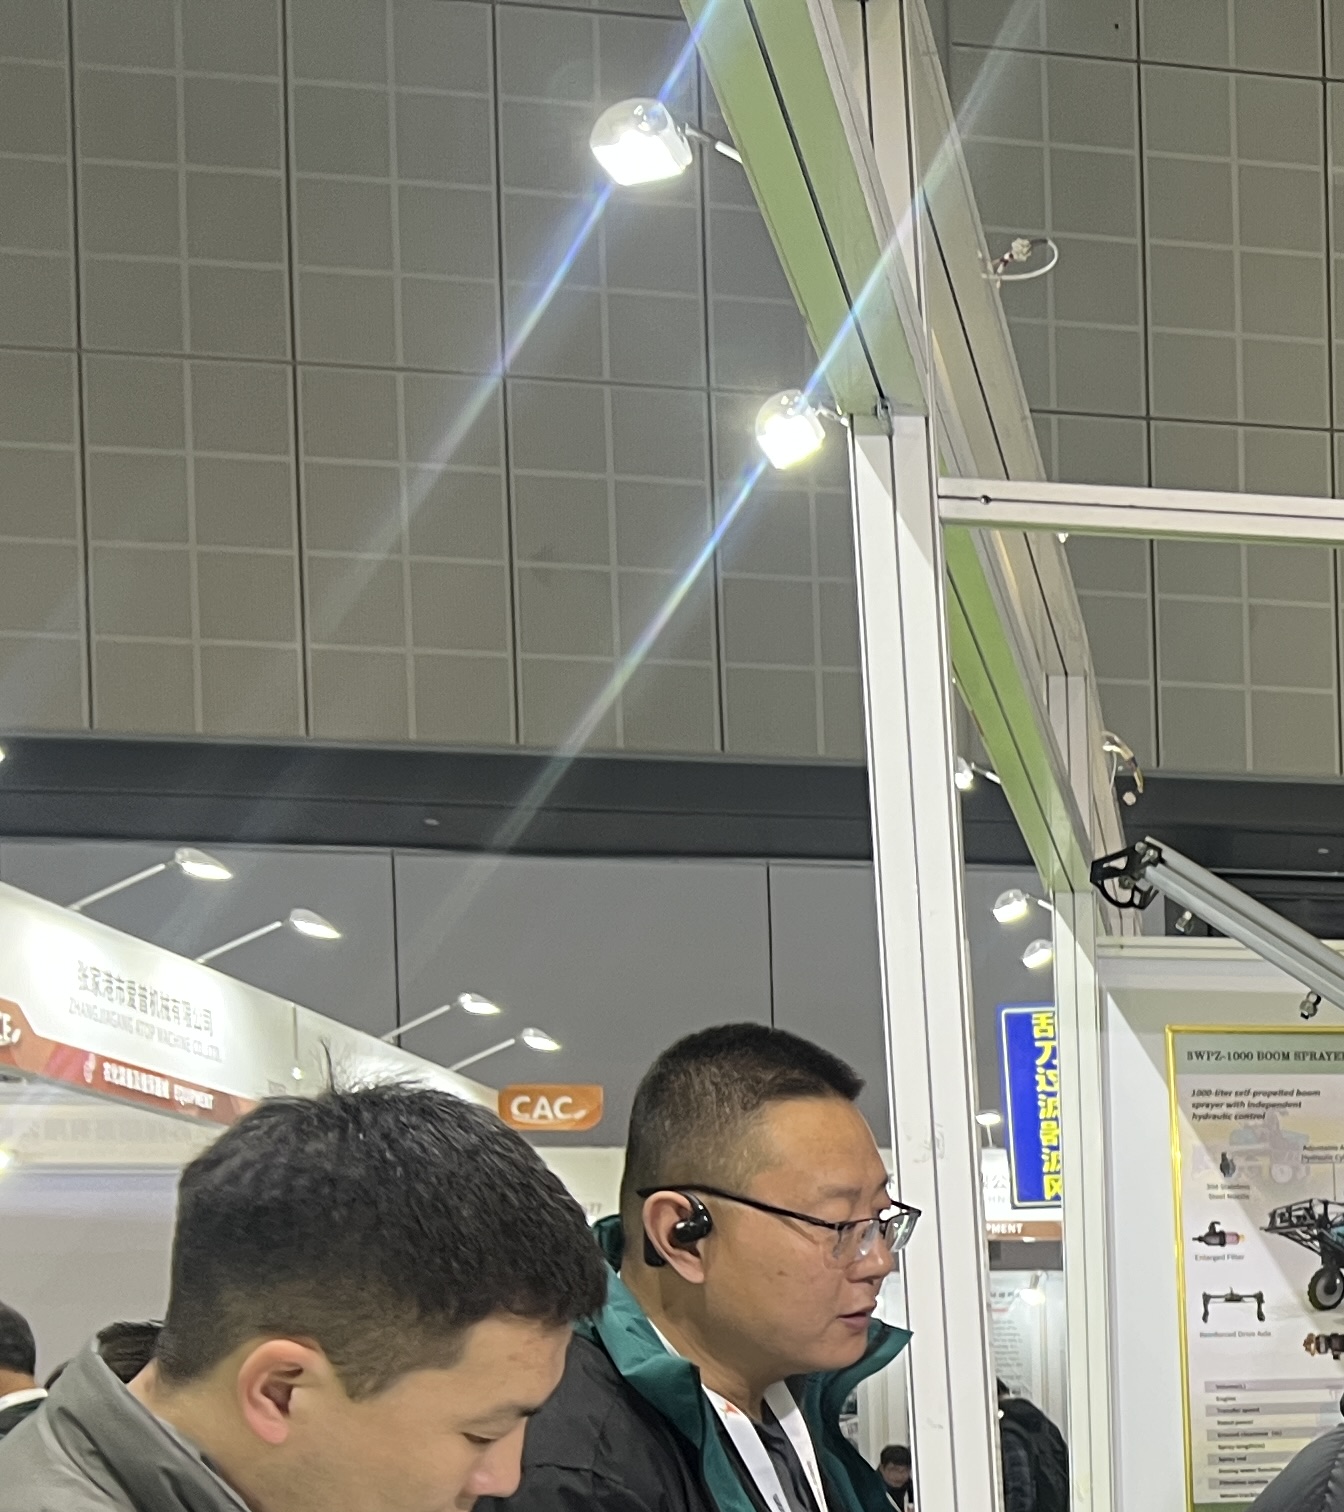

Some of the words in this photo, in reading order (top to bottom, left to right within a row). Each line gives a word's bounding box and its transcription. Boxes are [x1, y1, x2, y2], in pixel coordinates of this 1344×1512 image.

[1257, 1050, 1290, 1061] BOOM
[1296, 1088, 1321, 1097] boom
[510, 1095, 574, 1122] CAC
[1191, 1101, 1224, 1110] sprayer
[1226, 1100, 1246, 1109] with
[1247, 1100, 1302, 1110] independent
[1191, 1112, 1232, 1121] hydraulic
[1234, 1112, 1266, 1121] control
